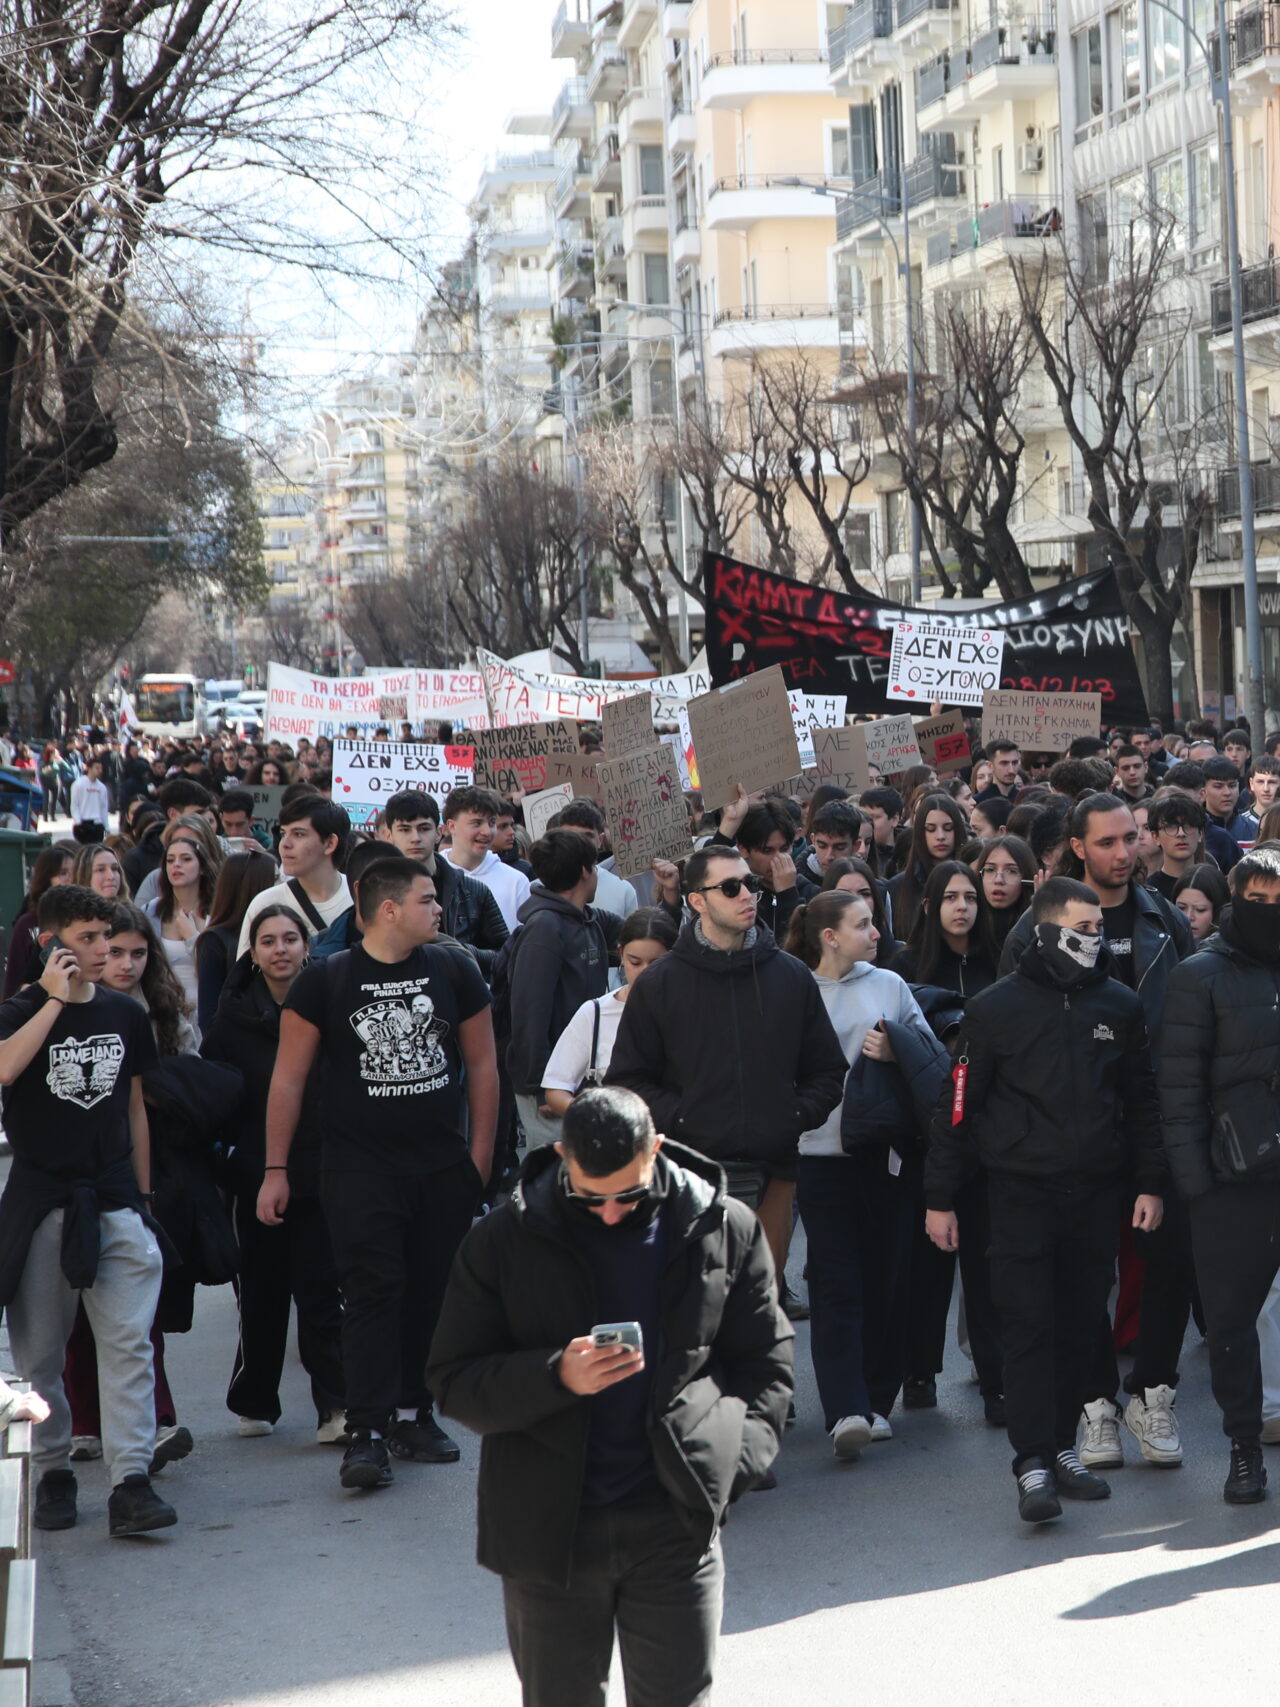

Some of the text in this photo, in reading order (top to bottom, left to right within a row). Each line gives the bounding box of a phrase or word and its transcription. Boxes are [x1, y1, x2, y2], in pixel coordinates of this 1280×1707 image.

[904, 637, 999, 665] ΔΕΝ ΕΧΩ
[310, 679, 328, 694] ΤΑ
[684, 673, 707, 693] ΤΑ
[908, 666, 997, 690] ΟΞΥΓΟΝΟ
[271, 689, 296, 705] ΠΟΤΕ
[301, 693, 322, 708] ΔΕΝ
[329, 698, 342, 710] ΘΑ
[989, 695, 1097, 712] ΔΕΝ ΗΤΑΝ ΑΤΥΧΗΜΑ
[606, 704, 620, 721] ΤΑ
[995, 714, 1091, 729] ΗΤΑΝ ΕΓΚΛΗΜΑ
[481, 725, 537, 745] ΜΠΟΡΟΥΣΕ
[545, 721, 568, 737] ΝΑ
[1013, 730, 1043, 744] ΕΙΧΕ
[451, 749, 470, 757] 57
[938, 739, 963, 758] 57
[348, 753, 441, 772] ΔΕΝ ΕΧΩ
[554, 763, 573, 778] ΤΑ
[601, 747, 675, 785] ΟΙ ΡΑΓΕΣ ΤΗΣ
[367, 776, 452, 793] ΟΞΥΓΟΝΟ
[643, 809, 670, 832] ΠΟΤΕ
[671, 806, 687, 822] ΔΕΝ
[617, 840, 634, 860] ΘΑ
[618, 861, 632, 875] ΤΟ
[373, 989, 403, 997] FINALS
[383, 981, 415, 990] EUROPE
[415, 977, 430, 986] CUP
[52, 1044, 123, 1066] HOMELAND
[367, 1074, 450, 1097] winmasters
